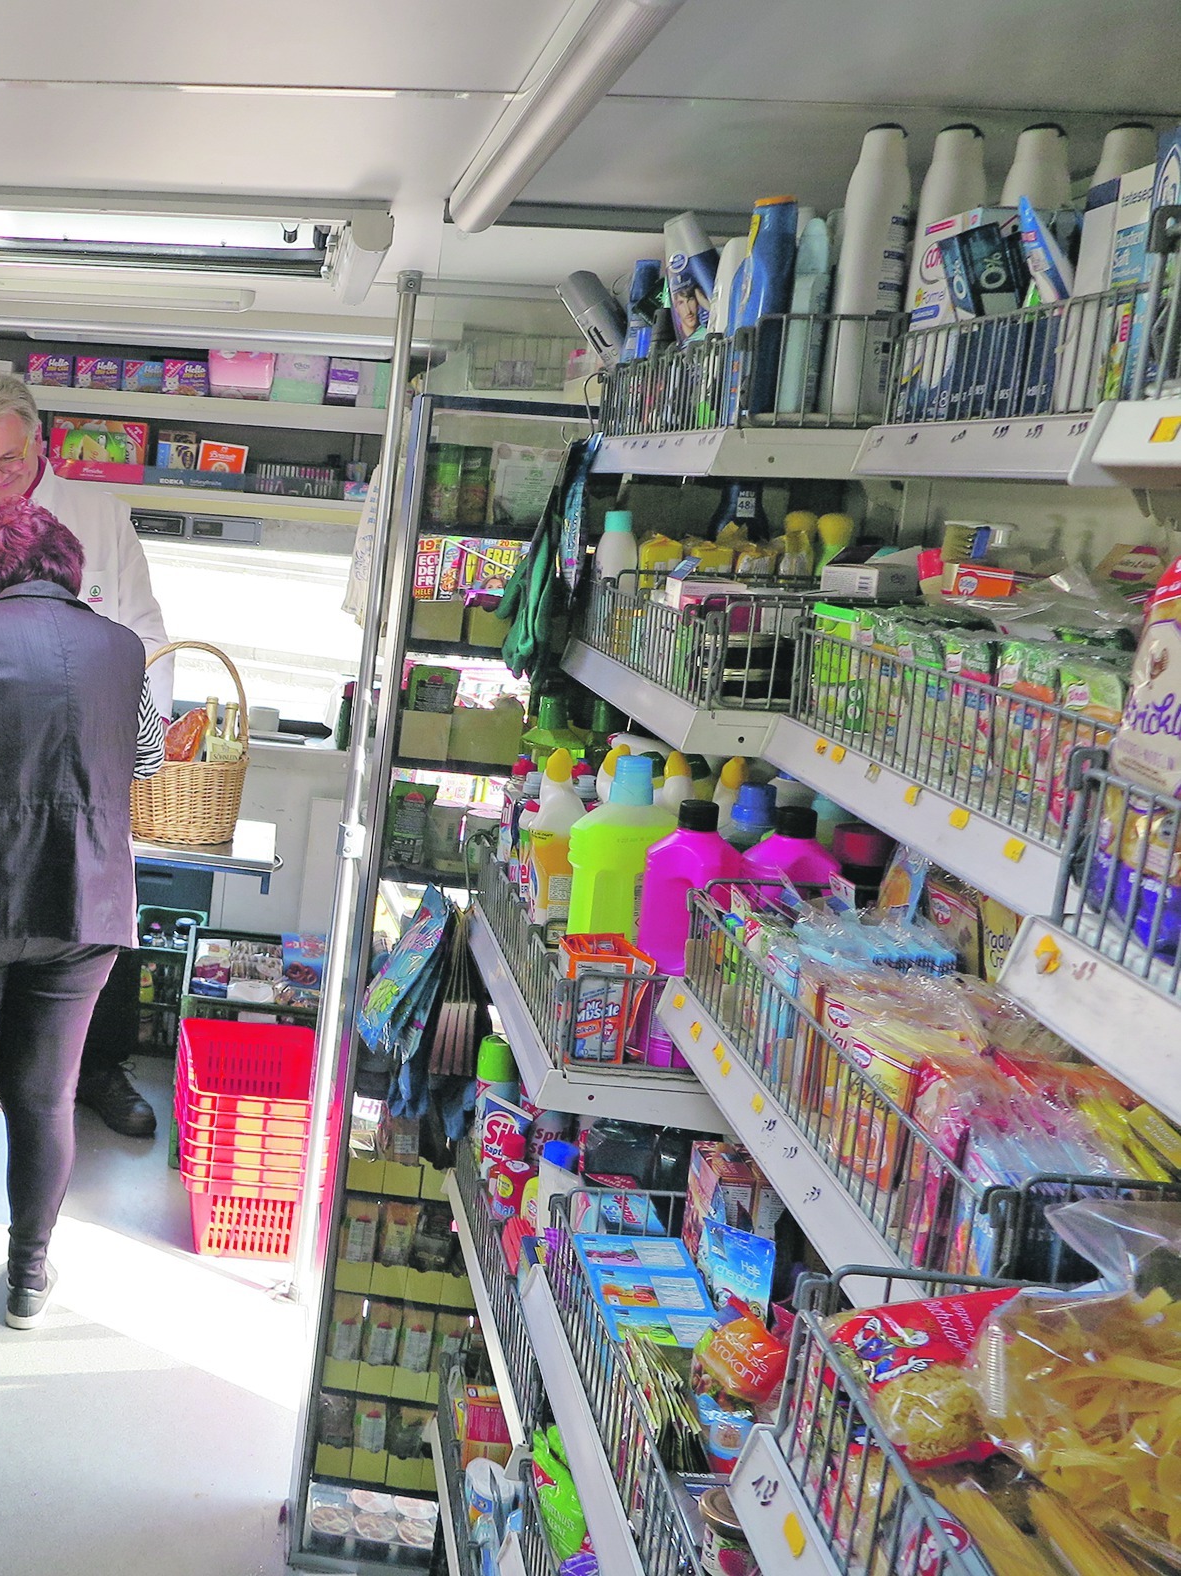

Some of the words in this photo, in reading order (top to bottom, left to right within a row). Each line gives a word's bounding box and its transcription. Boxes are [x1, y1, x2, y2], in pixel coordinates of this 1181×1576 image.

[159, 478, 184, 486] EDEKA
[419, 540, 435, 550] 19
[499, 539, 510, 547] 20
[586, 1000, 602, 1009] Mr
[710, 1338, 763, 1388] Krokant
[676, 1471, 716, 1480] EDEKA
